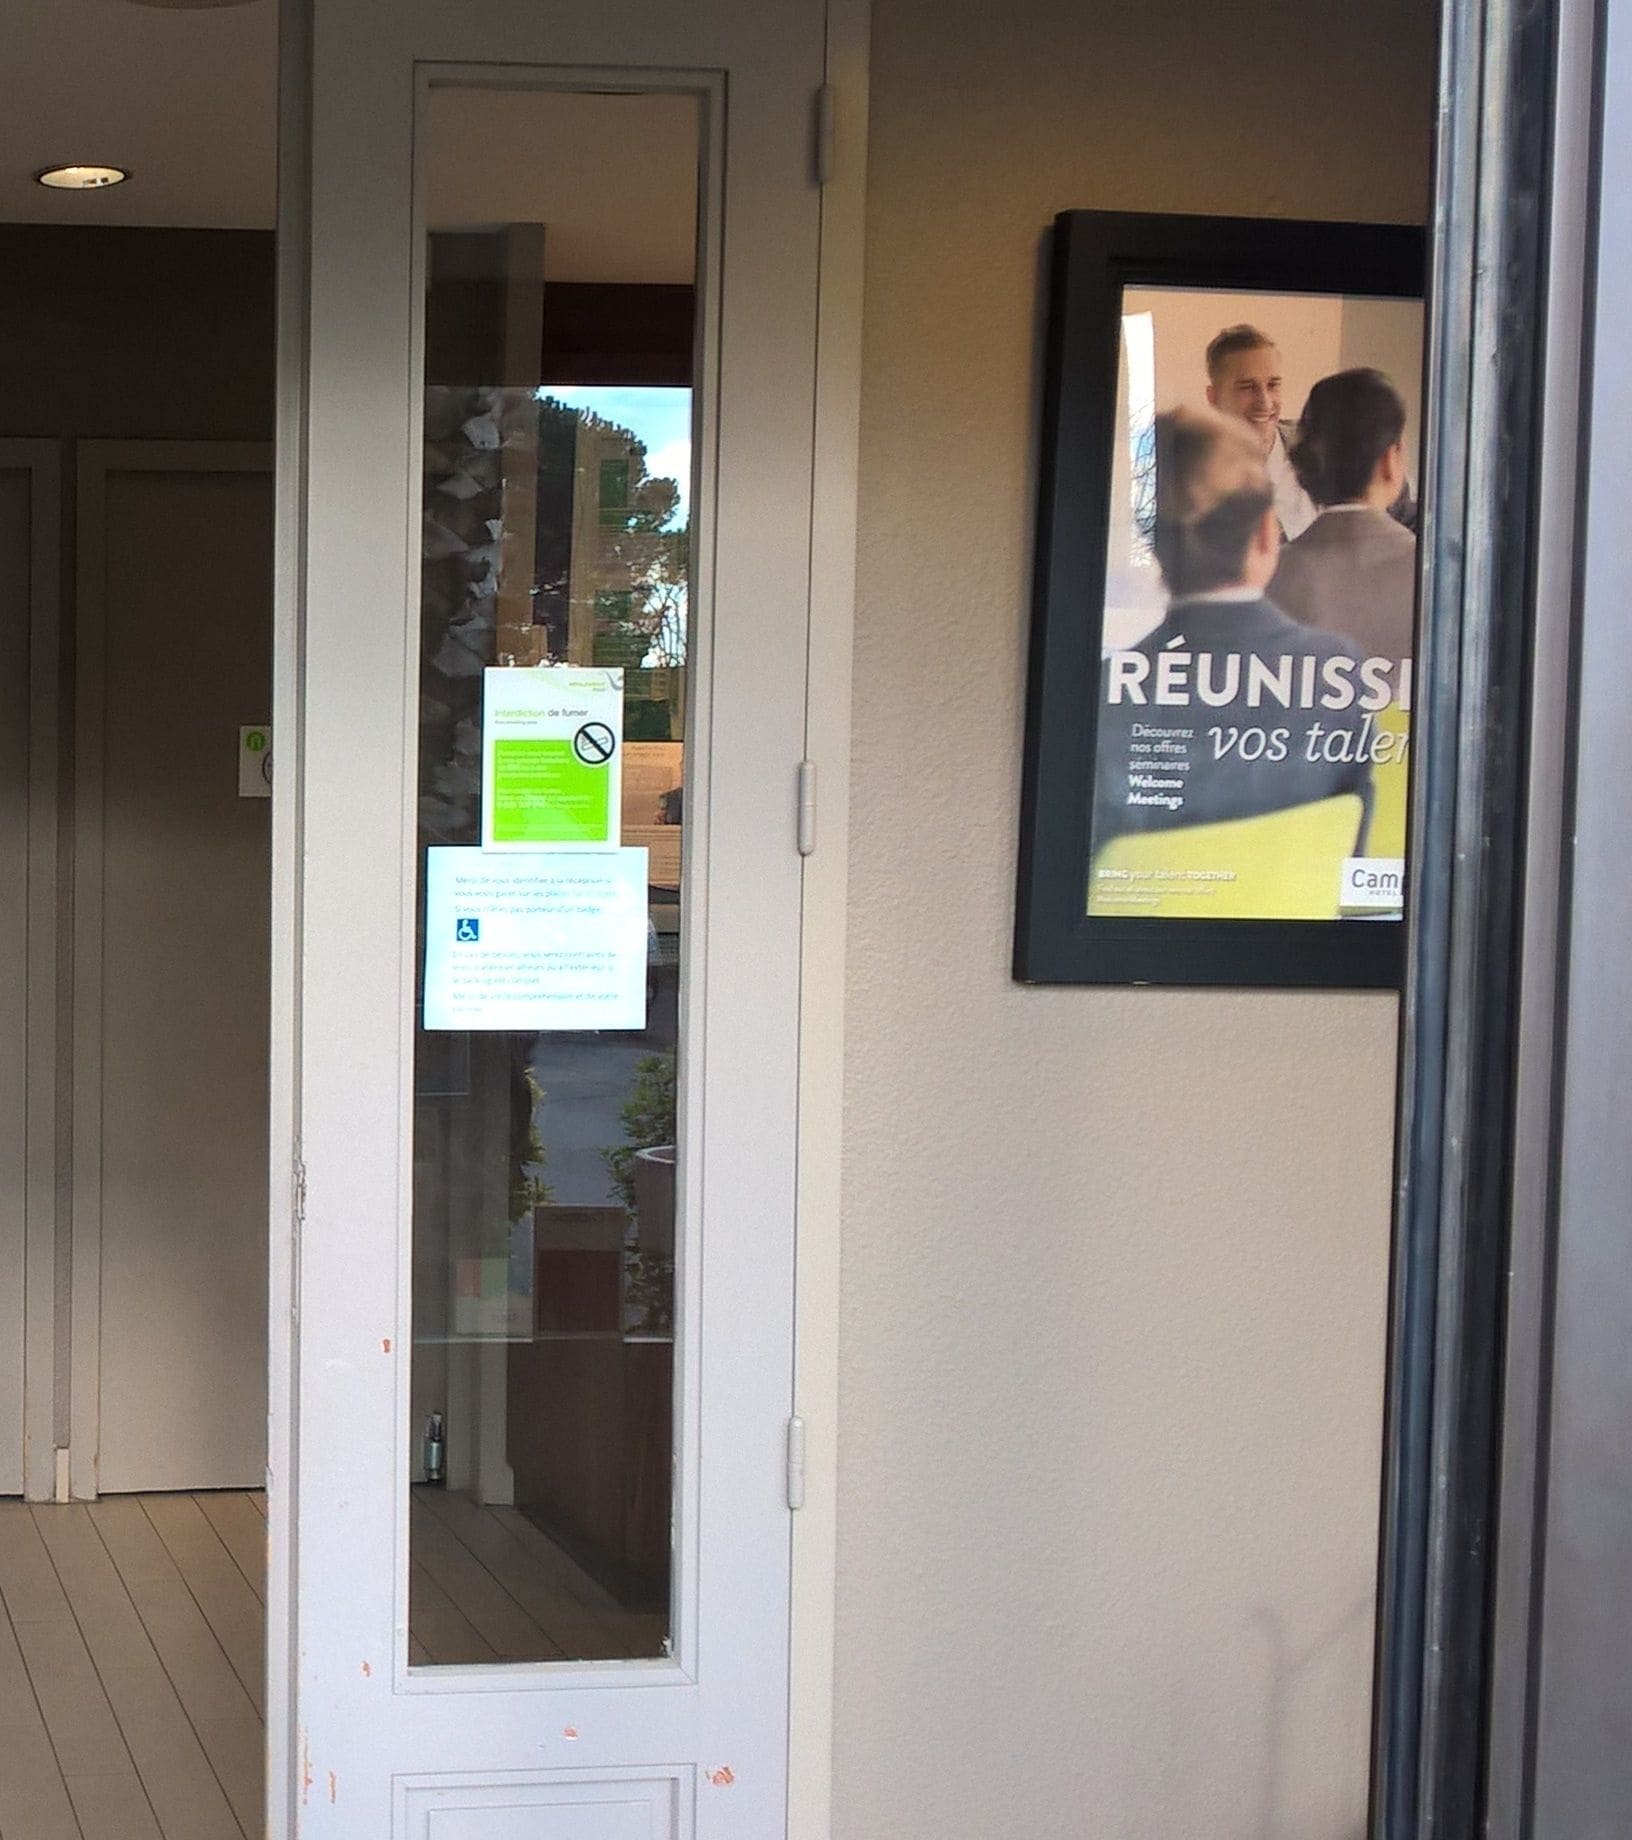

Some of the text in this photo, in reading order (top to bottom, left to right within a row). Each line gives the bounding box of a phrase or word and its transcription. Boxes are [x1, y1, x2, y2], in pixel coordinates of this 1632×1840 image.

[547, 708, 560, 718] de
[561, 708, 589, 719] fumer
[1131, 722, 1195, 739] Découvrez
[1129, 739, 1188, 755] nos offres
[1207, 725, 1291, 763] vos
[1128, 756, 1191, 772] séminaires
[1127, 773, 1185, 789] Welcome
[1125, 791, 1185, 811] Meetings
[1351, 868, 1399, 889] Cam
